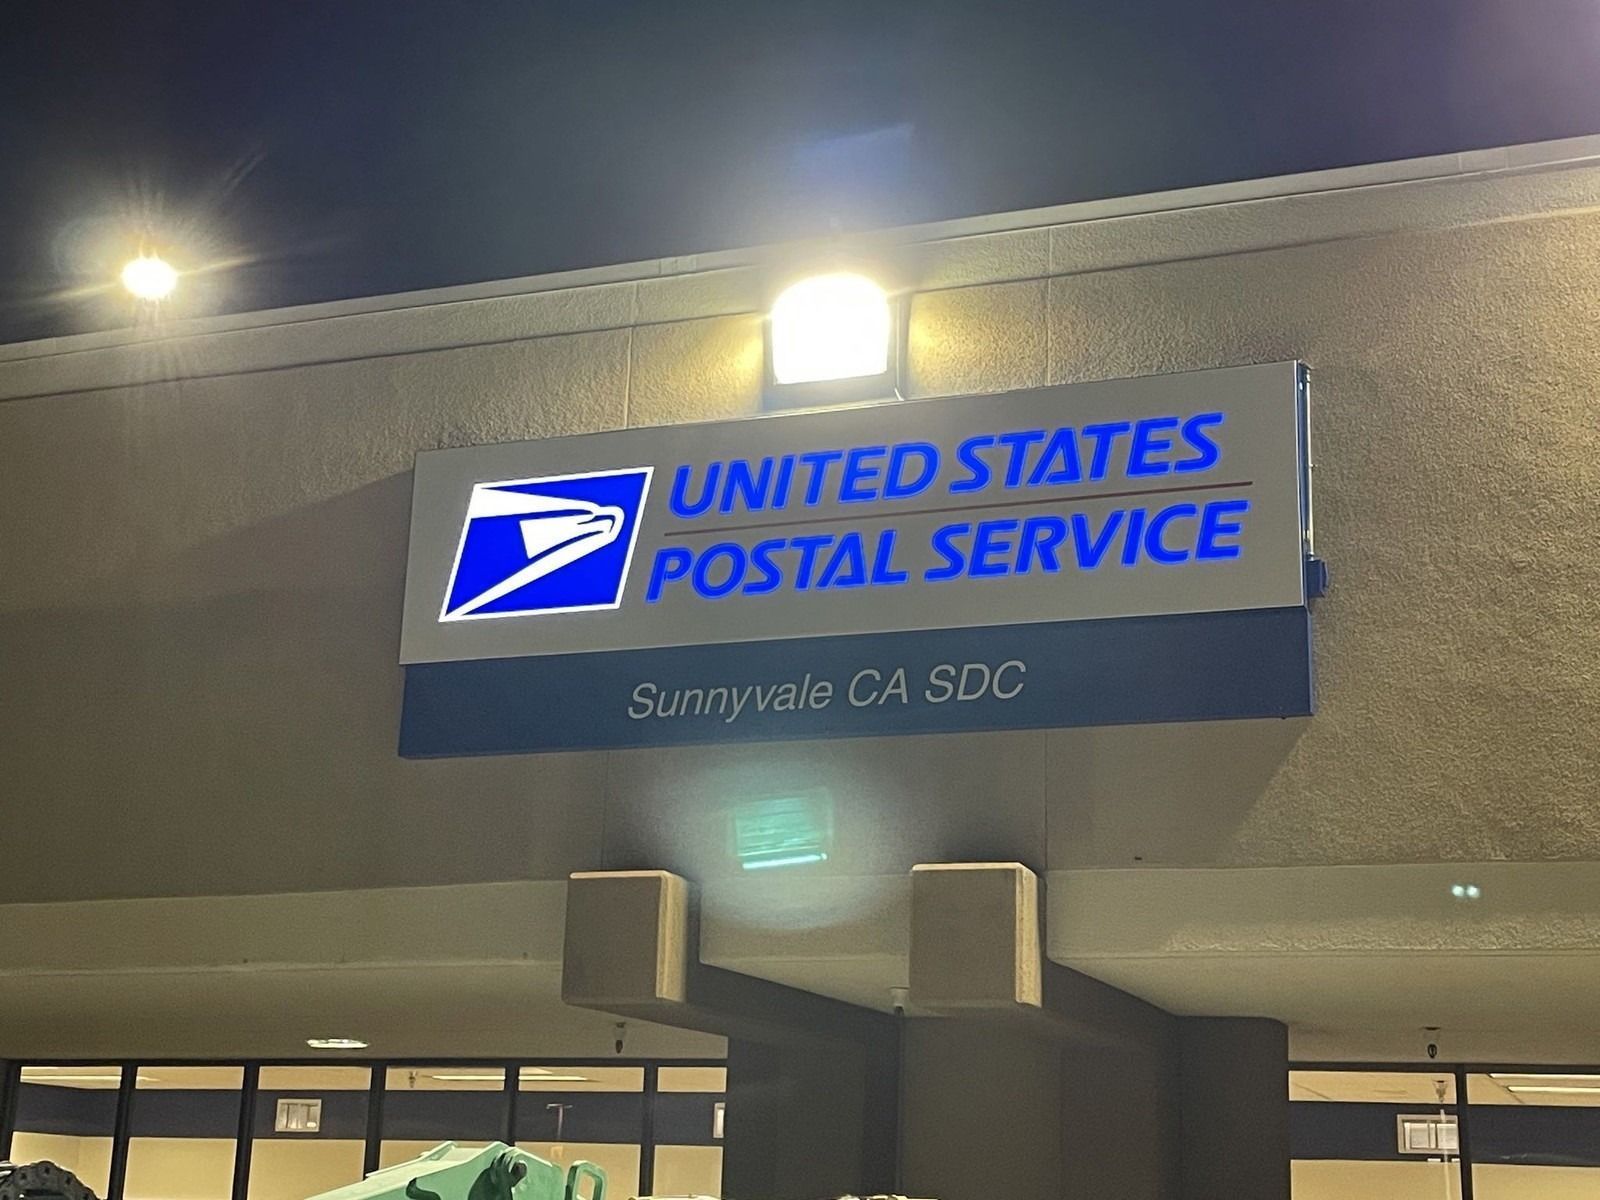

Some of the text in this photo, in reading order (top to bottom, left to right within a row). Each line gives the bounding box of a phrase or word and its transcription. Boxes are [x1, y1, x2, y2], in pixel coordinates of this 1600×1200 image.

[668, 411, 1226, 520] UNITED STATES
[645, 498, 1251, 604] POSTAL SERVICE
[628, 660, 1027, 723] Sunnyvale CA SDC
